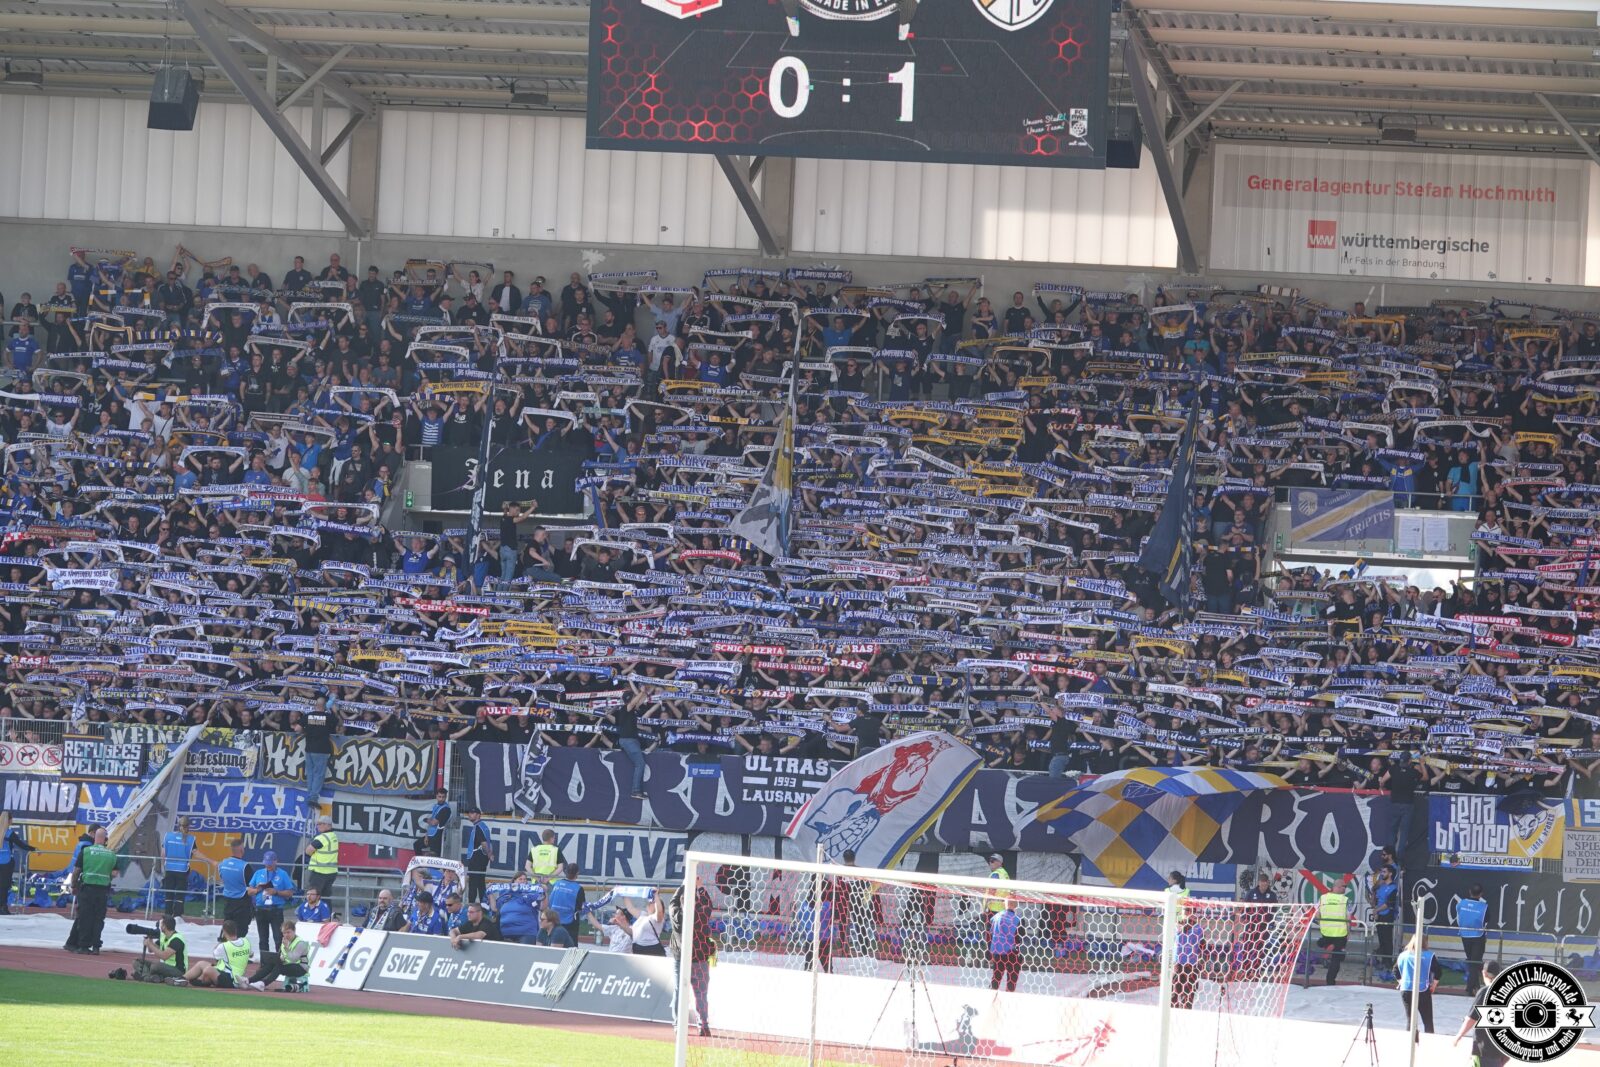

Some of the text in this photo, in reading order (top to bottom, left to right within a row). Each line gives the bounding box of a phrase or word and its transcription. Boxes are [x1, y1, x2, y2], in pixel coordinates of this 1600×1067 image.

[769, 55, 810, 118] 0
[889, 62, 915, 122] 1
[1247, 174, 1556, 203] Generalagentur Stefan Hochmuth
[1342, 233, 1490, 254] württembergische
[1355, 256, 1373, 266] Fels
[1375, 257, 1383, 266] in
[1386, 257, 1400, 267] der
[1345, 508, 1392, 538] TRIPTIS
[415, 603, 445, 612] SCHIC
[1458, 614, 1519, 626] SÜDKURVE
[715, 643, 784, 655] SCHIC KERIA
[852, 644, 873, 653] RAS
[1031, 665, 1055, 673] CHIC
[762, 690, 787, 698] RAS
[110, 726, 188, 745] WEIMA
[64, 740, 141, 760] REFUGEES
[200, 750, 247, 770] Festung
[263, 734, 433, 786] HAAKIRI
[63, 757, 140, 777] WELCOME
[745, 755, 829, 776] ULTRAS
[773, 776, 797, 788] 1993
[4, 779, 78, 813] MIND
[85, 783, 310, 817] WIMAR
[743, 788, 815, 804] LAUSANN
[202, 832, 273, 850] JENA
[1575, 842, 1600, 850] SPIE
[1411, 877, 1593, 934] Salfeld
[387, 952, 505, 984] SWE Für Erfurt.
[528, 966, 652, 999] SW Für Erfurt.
